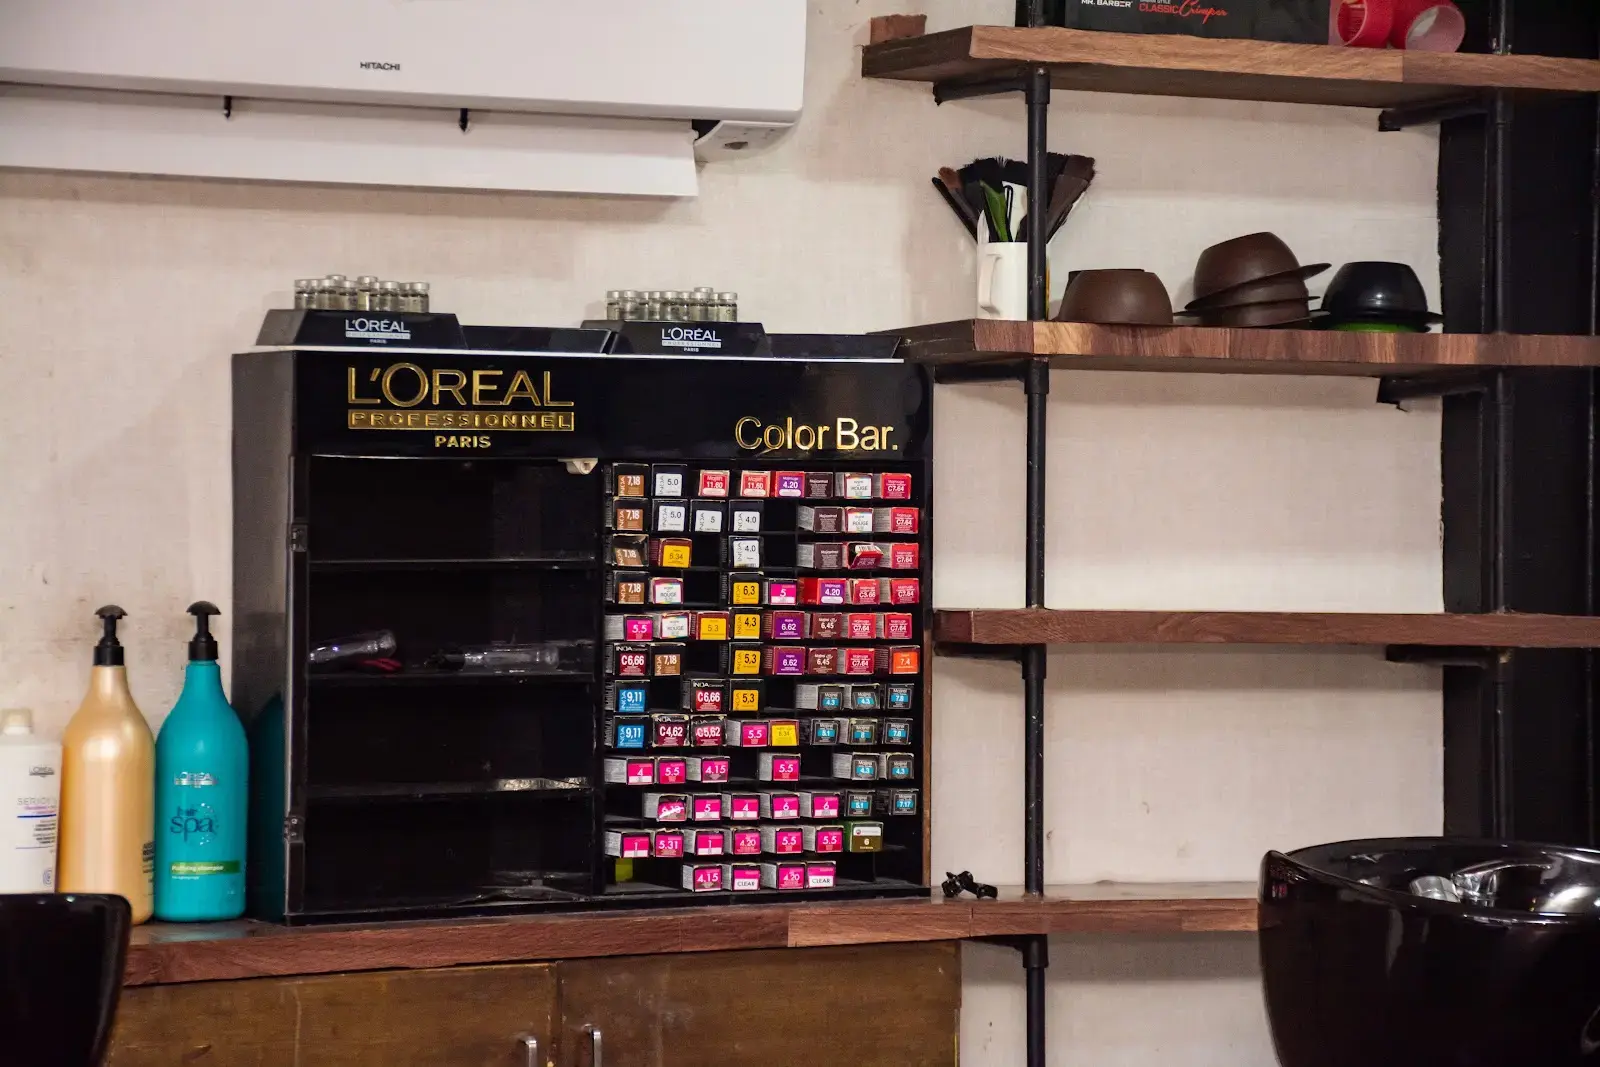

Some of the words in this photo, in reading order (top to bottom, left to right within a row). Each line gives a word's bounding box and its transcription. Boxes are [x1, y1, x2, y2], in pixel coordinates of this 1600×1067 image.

[1138, 3, 1179, 13] CLASSIC
[360, 62, 400, 70] HITACHI
[345, 318, 411, 333] L'ORÉAL
[662, 328, 722, 341] L'ORÉAL
[351, 413, 572, 428] PROFESSIONNEL
[735, 416, 830, 450] Color
[837, 417, 898, 450] Bar.
[434, 435, 491, 448] PARIS
[627, 476, 641, 486] 7,18
[626, 510, 640, 520] 7,18
[622, 550, 637, 558] 7,18
[628, 584, 641, 593] 7,18
[743, 585, 756, 596] 6,3
[780, 589, 787, 597] 5
[744, 617, 757, 627] 4,3
[632, 625, 647, 633] 5.5
[621, 655, 645, 667] C6,66
[664, 655, 677, 665] 7,18
[744, 654, 757, 664] 5,3
[627, 692, 642, 703] 9,11
[697, 692, 720, 703] C6,66
[742, 693, 755, 704] 5,3
[626, 728, 641, 739] 9,11
[660, 726, 683, 737] C4,62
[697, 727, 720, 738] C5,62
[748, 730, 762, 739] 5.5
[637, 768, 643, 776] 4
[665, 767, 680, 776] 5.5
[705, 765, 726, 774] 4.15
[779, 764, 794, 773] 5.5
[704, 804, 711, 812] 5
[743, 803, 749, 811] 4
[783, 802, 789, 810] 6
[823, 801, 829, 810] 6
[170, 816, 217, 842] spa
[659, 841, 678, 849] 5.31
[782, 837, 797, 845] 5.5
[823, 836, 837, 845] 5.5
[697, 873, 719, 883] 4.15
